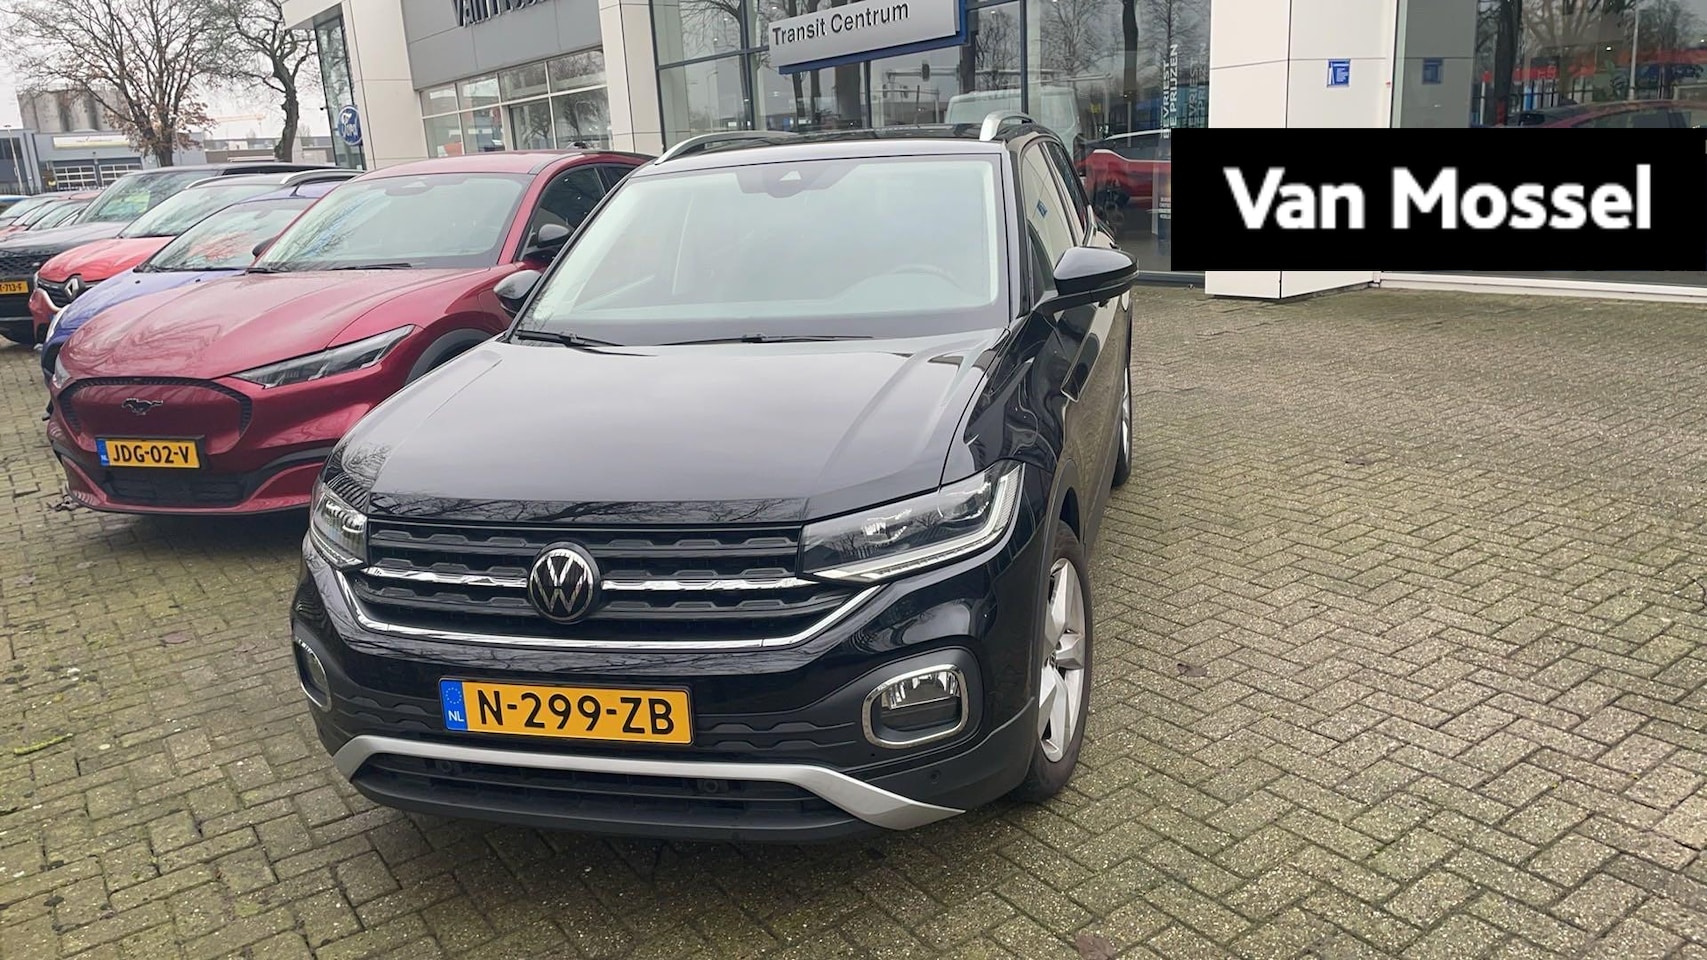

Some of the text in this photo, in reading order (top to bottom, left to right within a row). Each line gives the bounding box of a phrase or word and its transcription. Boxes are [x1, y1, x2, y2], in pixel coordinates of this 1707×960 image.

[772, 2, 909, 46] Transit Centrum
[1169, 43, 1178, 113] PRIJZEN
[113, 444, 189, 463] JDG-02-V
[448, 689, 675, 735] NL N-299-ZB
